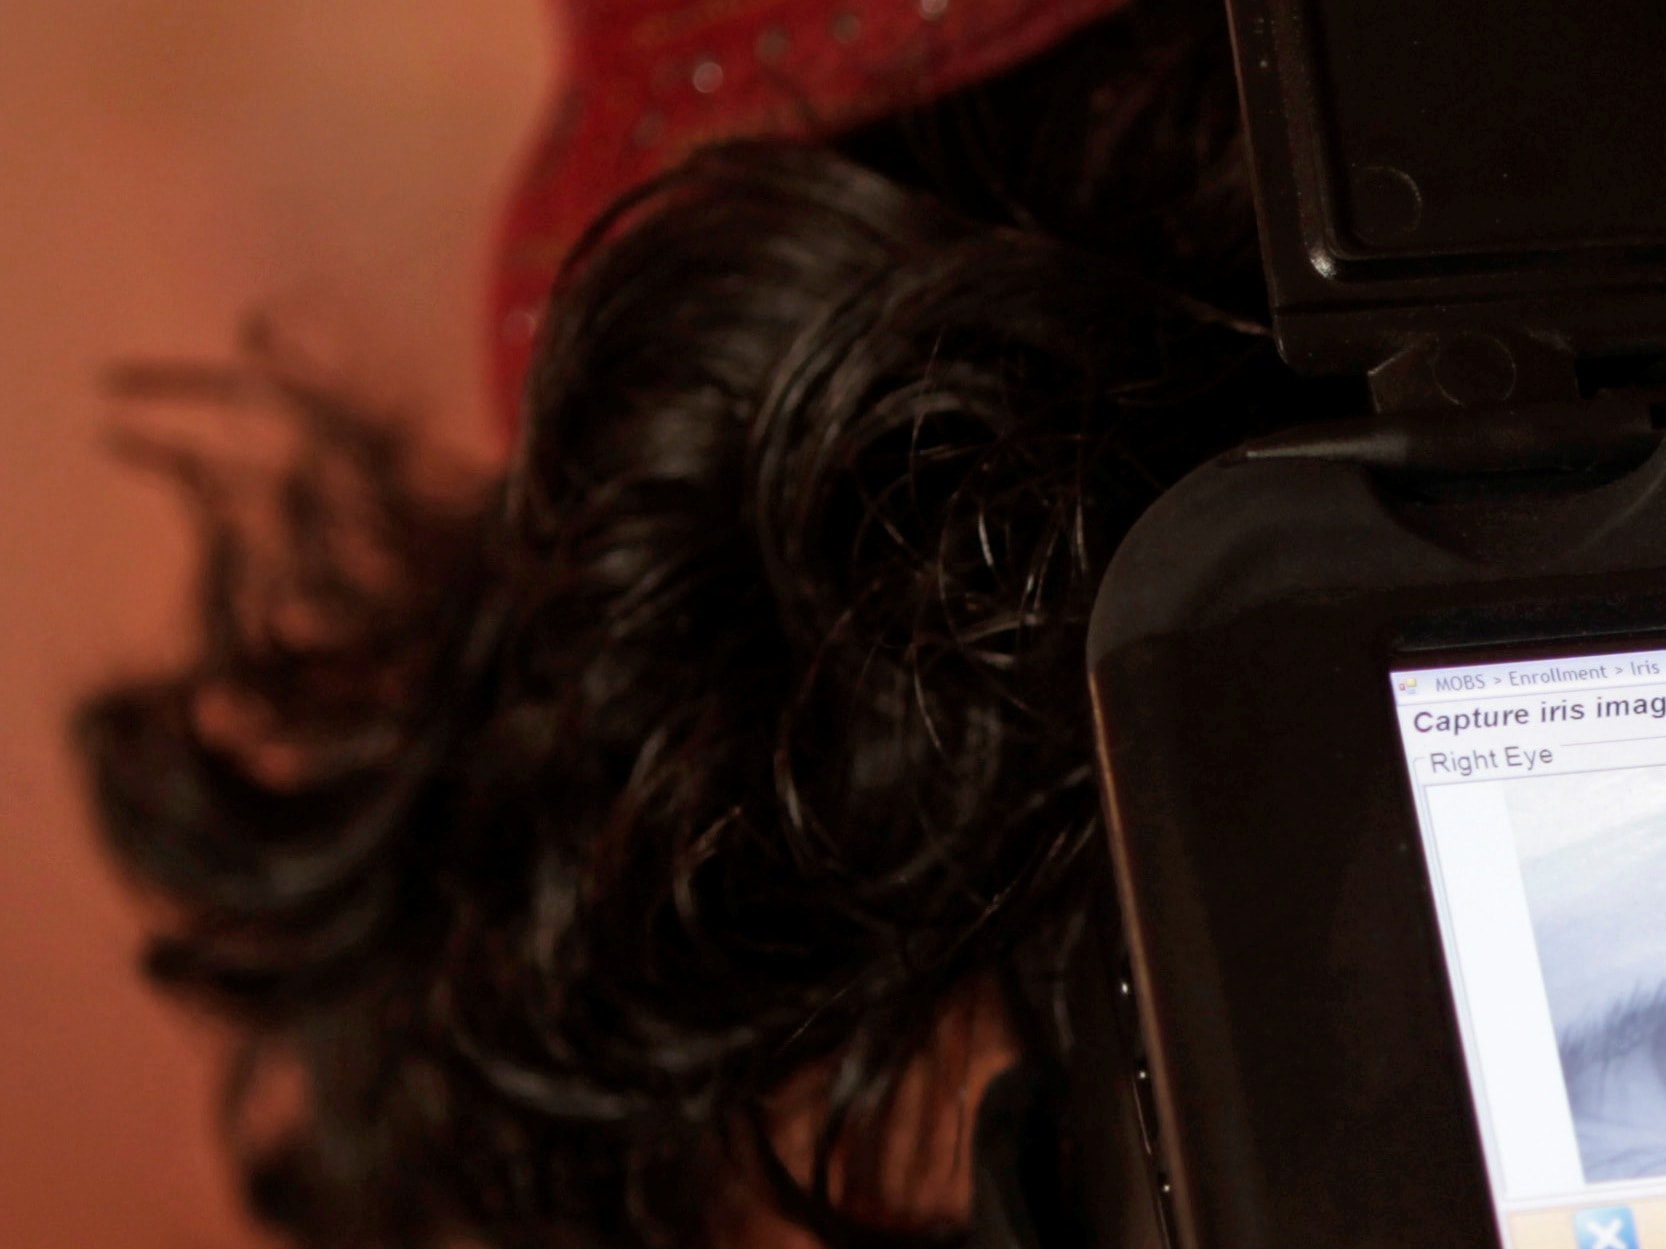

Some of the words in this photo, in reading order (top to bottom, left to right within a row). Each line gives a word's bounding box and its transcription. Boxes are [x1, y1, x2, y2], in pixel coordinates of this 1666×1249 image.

[1434, 675, 1486, 693] MOBS
[1508, 666, 1608, 688] Enrollment
[1629, 660, 1661, 677] Iris
[1413, 706, 1530, 736] Capture
[1540, 700, 1586, 724] iris
[1429, 749, 1499, 777] Right
[1504, 746, 1554, 772] Eye
